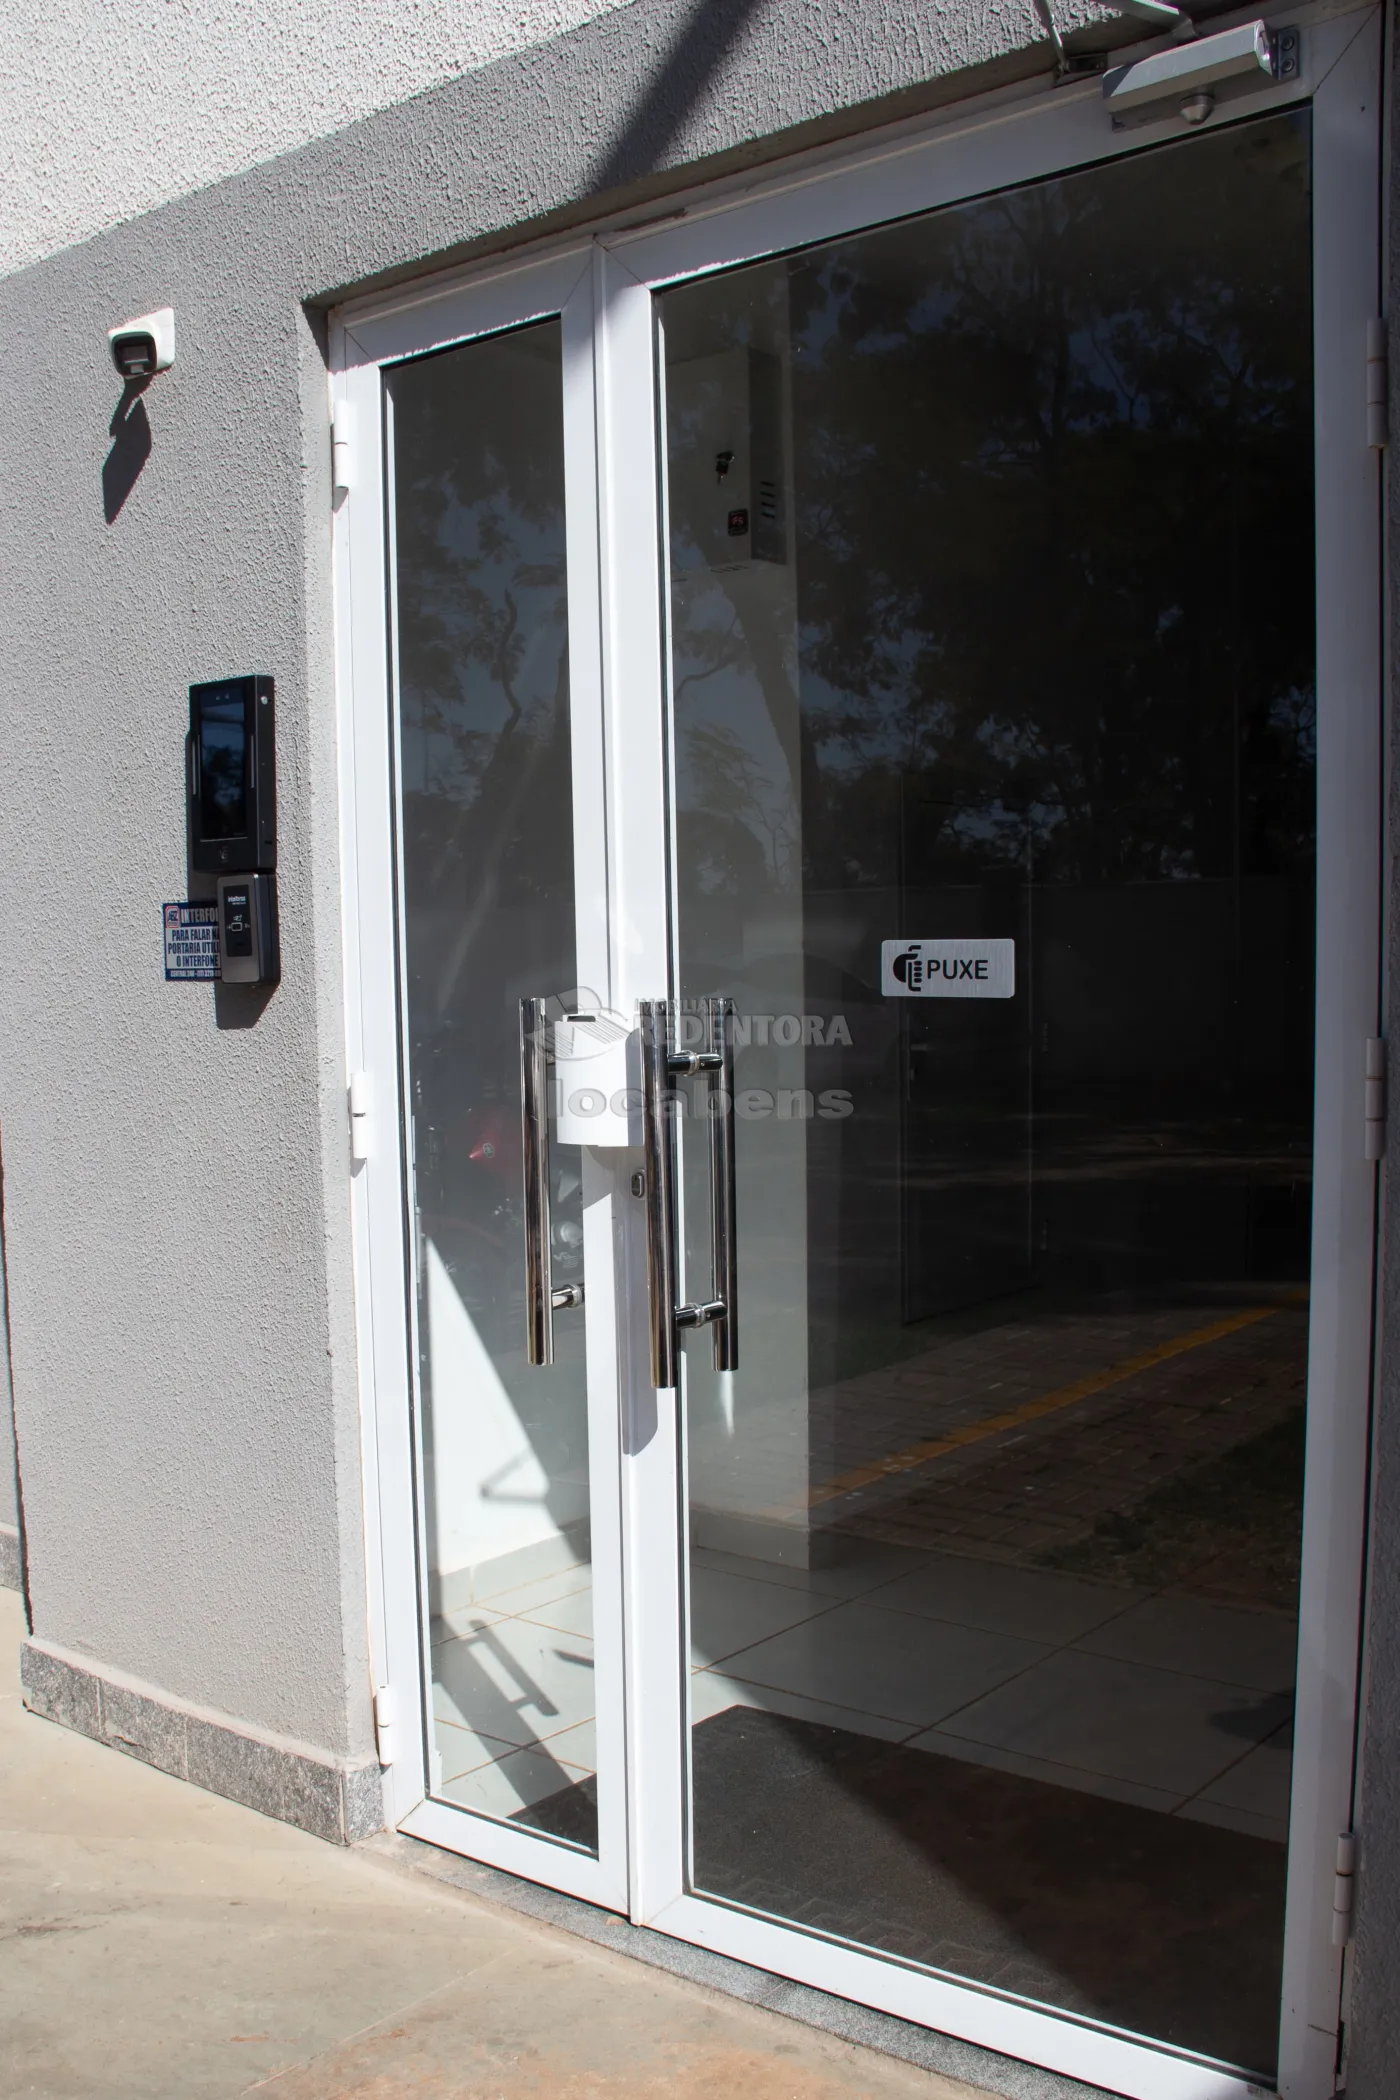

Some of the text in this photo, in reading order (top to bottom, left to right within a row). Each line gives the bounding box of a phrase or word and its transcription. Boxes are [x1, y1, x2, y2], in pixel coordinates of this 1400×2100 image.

[181, 908, 219, 923] INTERFO
[172, 929, 189, 941] PARA
[190, 928, 211, 940] FALAR
[168, 942, 201, 954] PORTARIA
[176, 955, 219, 967] O INTERFONE
[927, 959, 988, 980] PUXE
